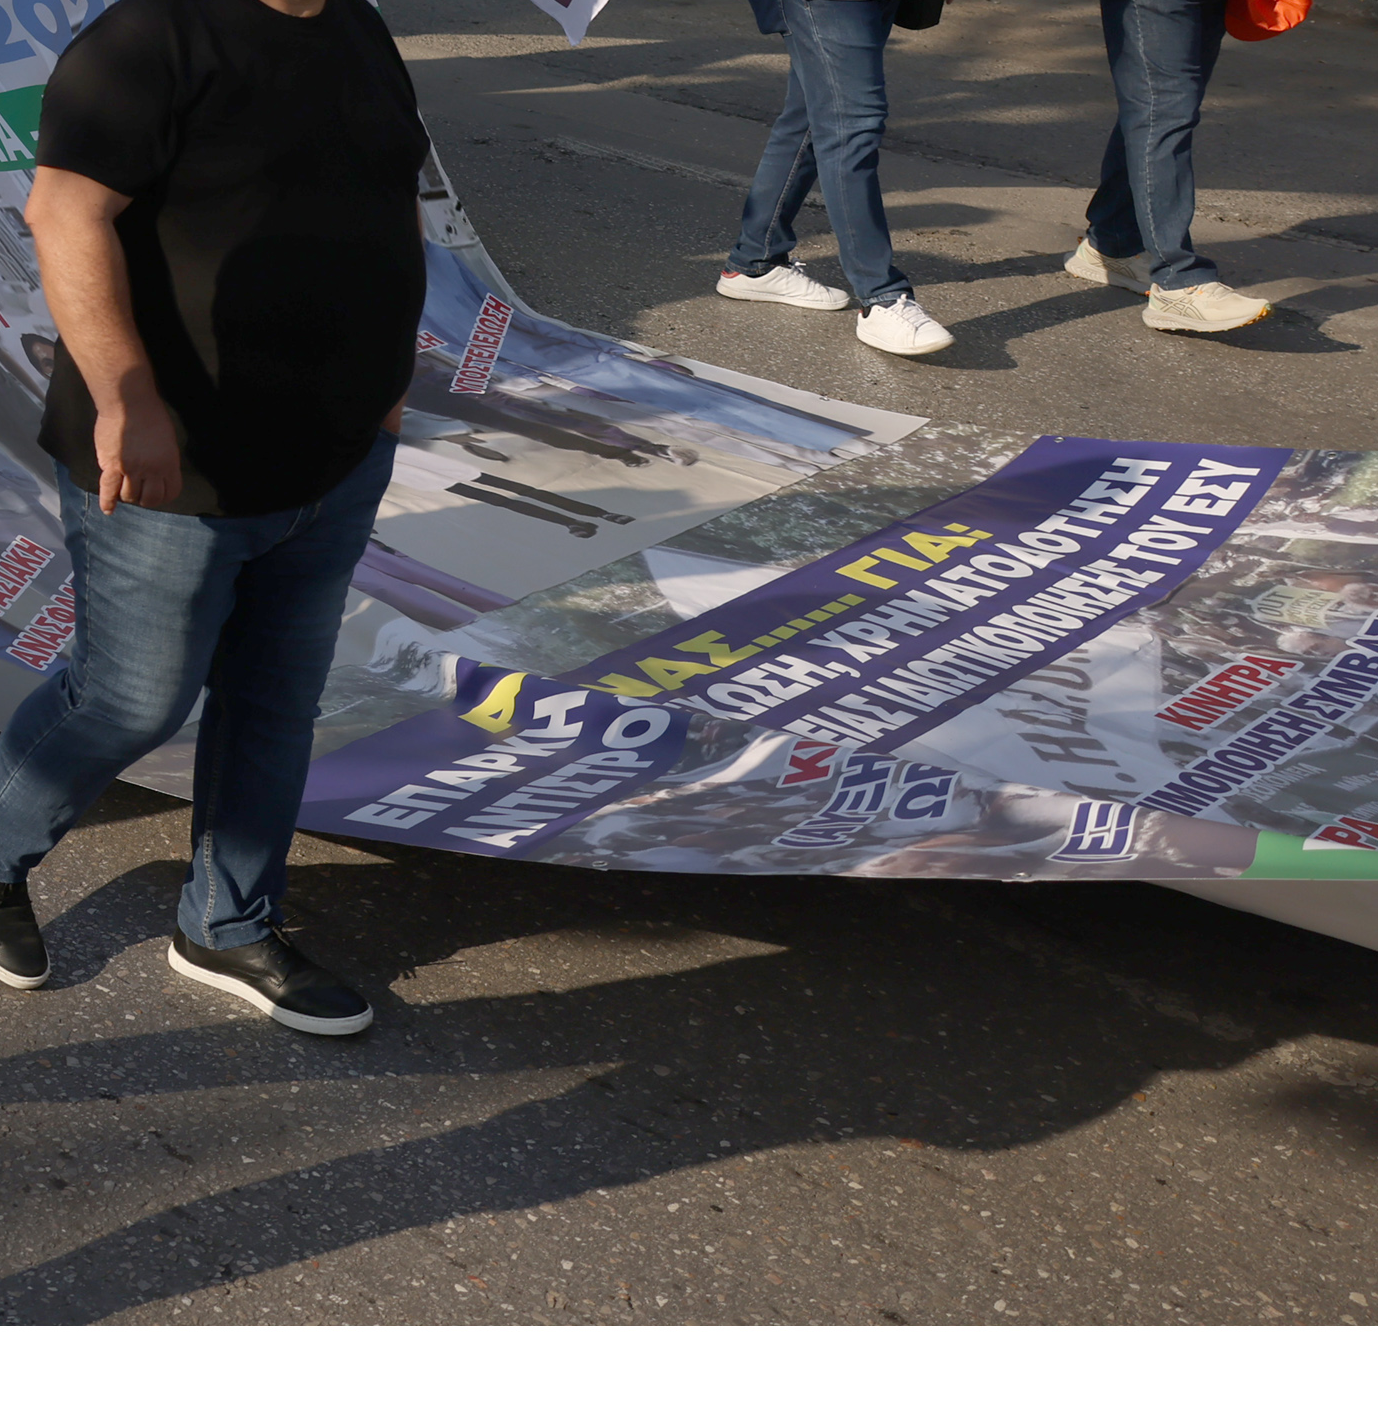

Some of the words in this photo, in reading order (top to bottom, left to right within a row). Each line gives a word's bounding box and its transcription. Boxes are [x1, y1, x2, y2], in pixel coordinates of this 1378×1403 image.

[450, 293, 514, 394] ΥΠΟΣΤΕΛΕΧΩΣΗ
[1160, 457, 1262, 517] ΕΣΥ
[834, 521, 995, 590] ΓΙΑ:
[1107, 514, 1214, 566] ΤΟΥ
[664, 653, 862, 721] ΧΩΣΗ,
[807, 457, 1173, 664] ΧΡΗΜΑΤΟΔΟΤΗΣΗ
[860, 558, 1166, 713] ΙΔΙΩΤΙΚΟΠΟΙΗΣΗΣ
[1154, 655, 1298, 732] ΚΙΝΗΤΡΑ
